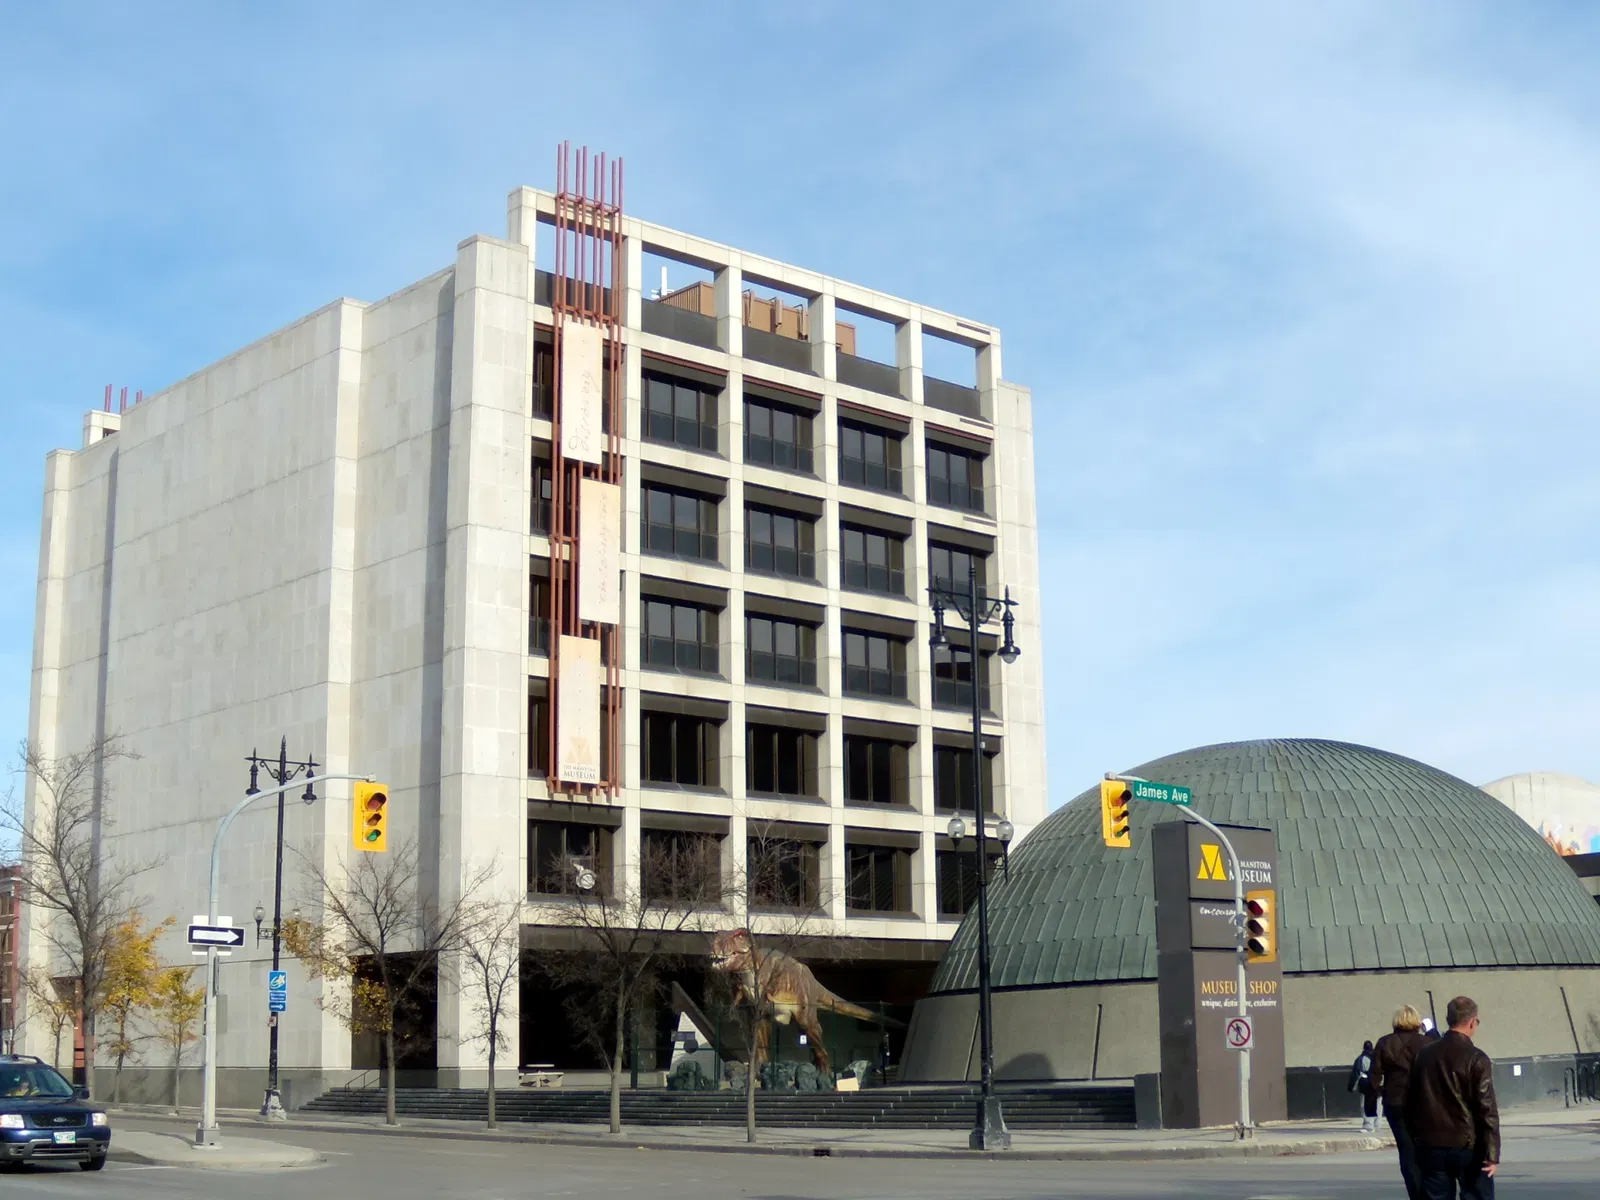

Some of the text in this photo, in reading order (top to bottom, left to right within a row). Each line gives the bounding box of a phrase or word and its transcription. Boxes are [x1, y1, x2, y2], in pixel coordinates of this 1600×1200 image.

[563, 770, 596, 780] MUSEUM
[1136, 783, 1188, 803] James Ave
[1240, 860, 1272, 870] MANITOBA
[1201, 980, 1277, 995] MUSEU SHOP
